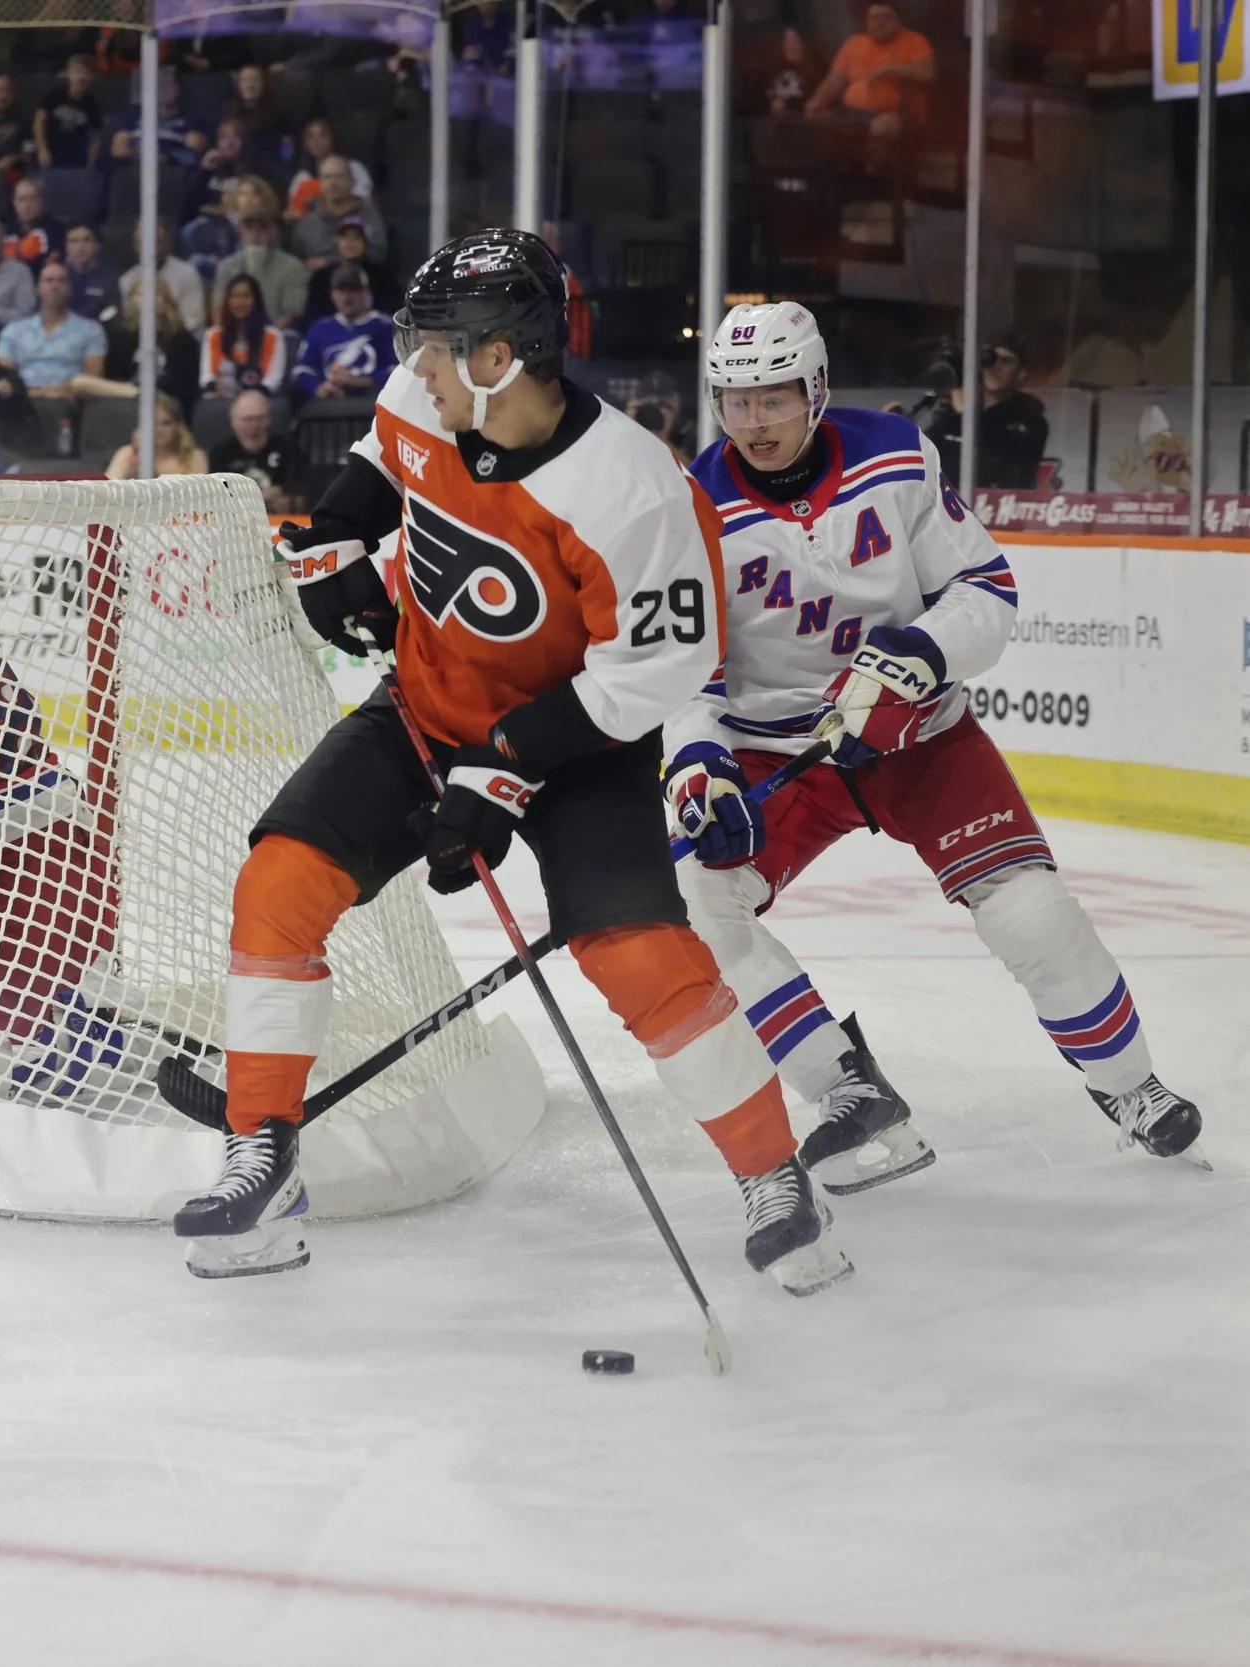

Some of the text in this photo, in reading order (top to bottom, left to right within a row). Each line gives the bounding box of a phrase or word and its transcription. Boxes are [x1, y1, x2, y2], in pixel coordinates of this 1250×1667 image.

[453, 262, 512, 279] CHEVROLET
[730, 325, 757, 341] 60
[725, 358, 759, 367] CCM
[397, 437, 430, 482] IBX
[850, 505, 892, 568] A
[630, 578, 706, 648] 29
[1134, 615, 1163, 651] PA
[853, 650, 937, 697] CCM
[936, 809, 1016, 851] CCM
[404, 967, 507, 1053] CCM
